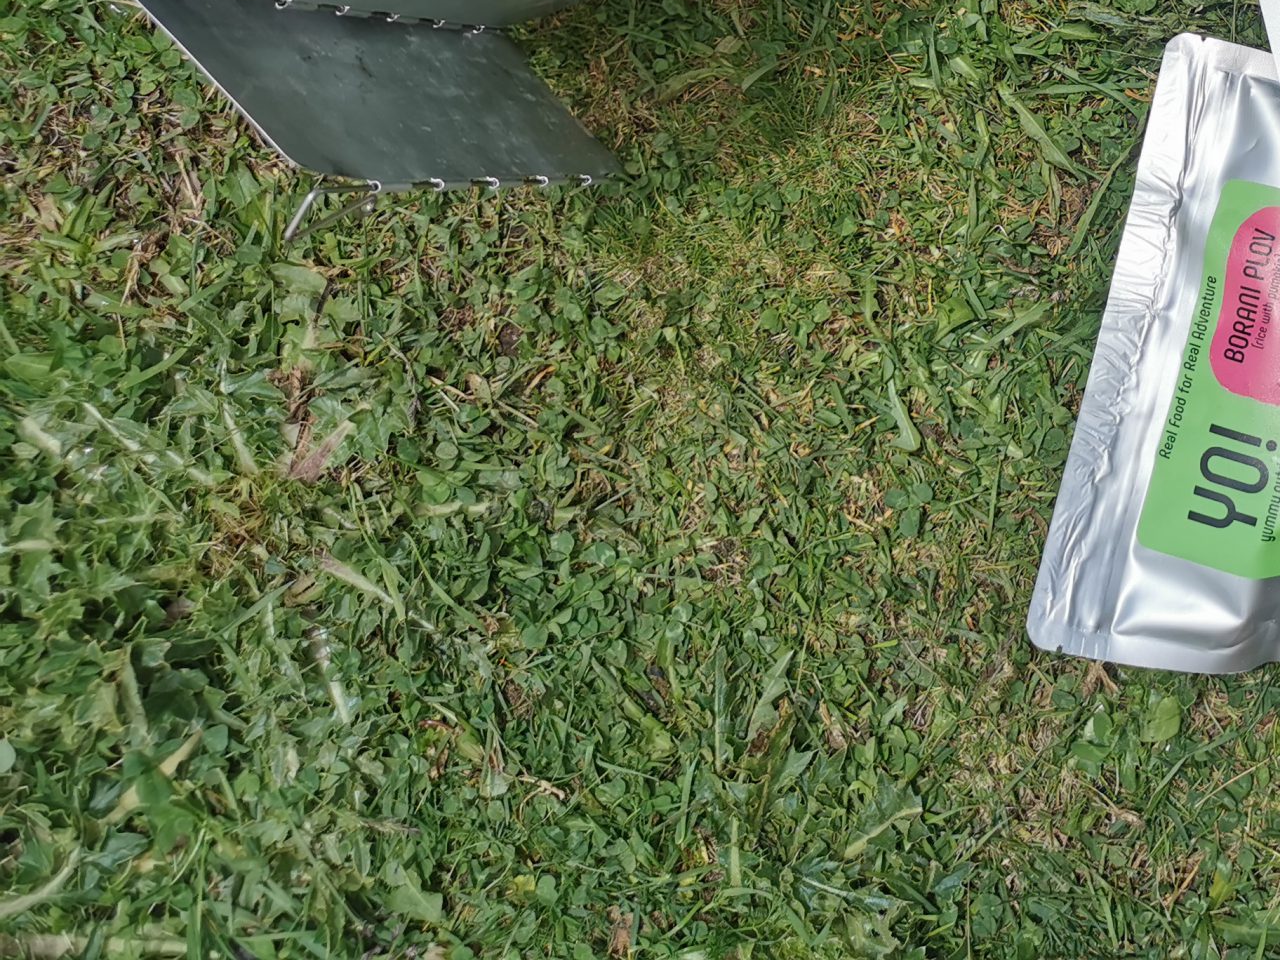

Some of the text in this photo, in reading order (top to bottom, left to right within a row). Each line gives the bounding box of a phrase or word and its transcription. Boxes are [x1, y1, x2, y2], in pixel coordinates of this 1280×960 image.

[1223, 226, 1276, 363] BORANI PLOV
[1251, 326, 1268, 350] (rice
[1258, 302, 1272, 325] with
[1158, 275, 1217, 460] Real Food for Real Adventure
[1188, 424, 1276, 528] YO!
